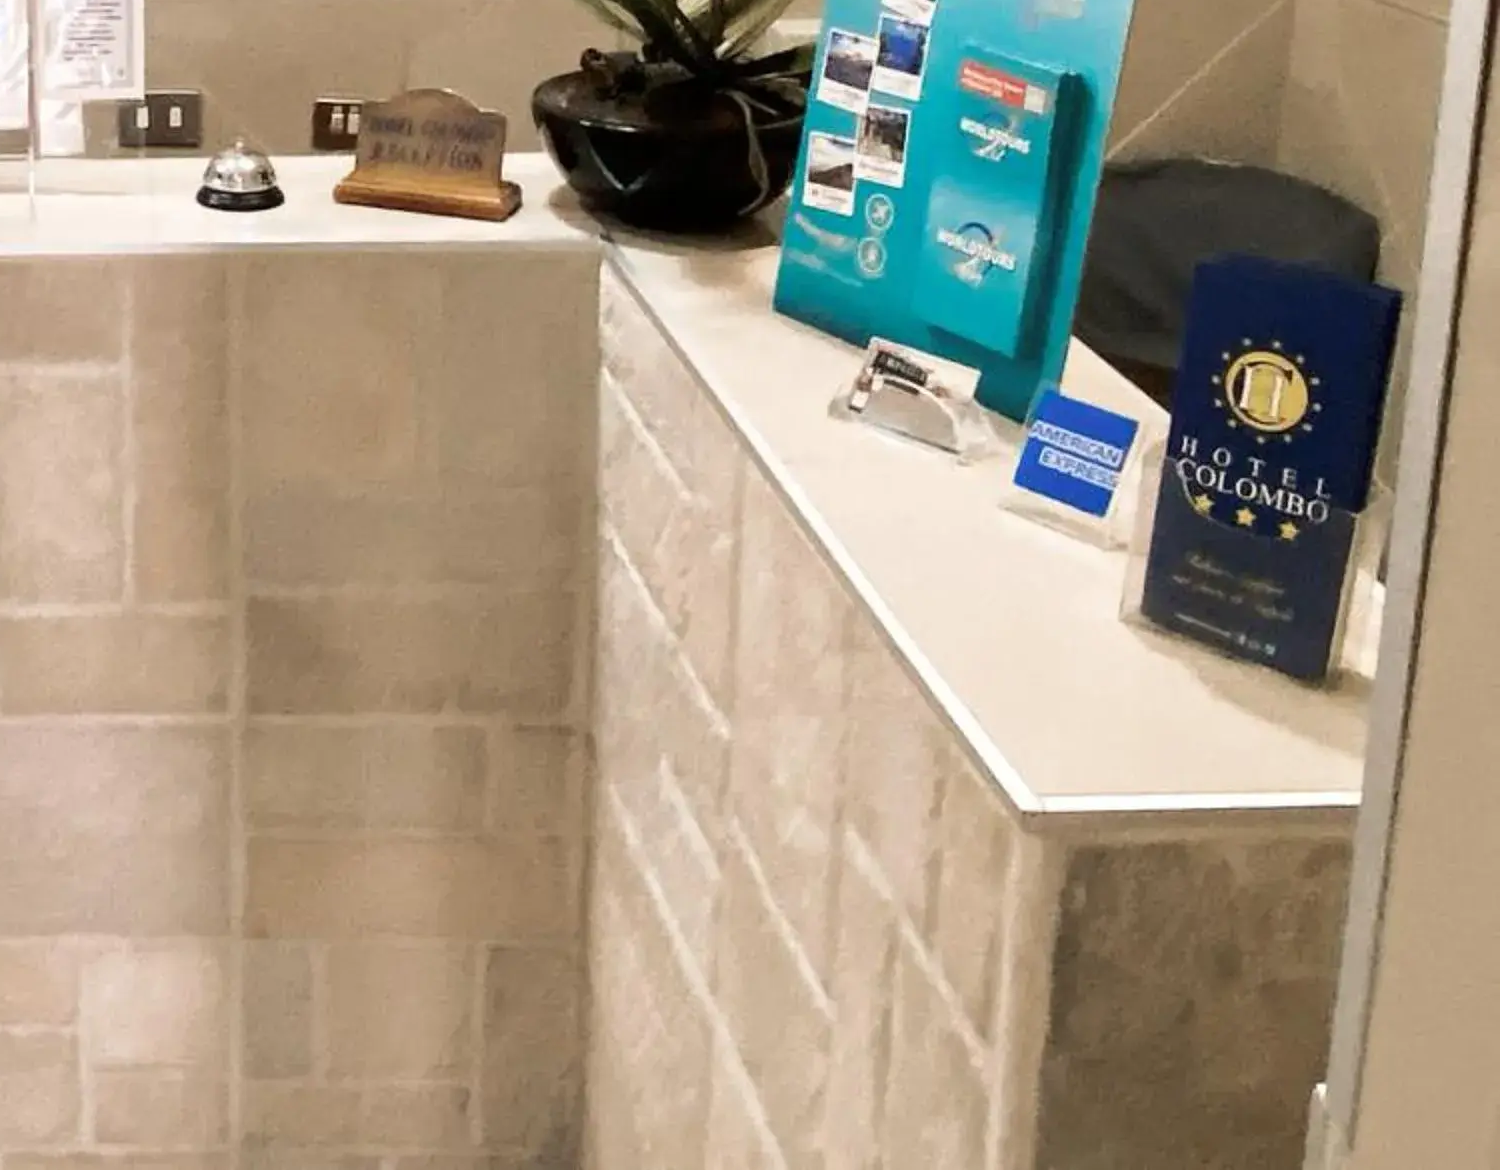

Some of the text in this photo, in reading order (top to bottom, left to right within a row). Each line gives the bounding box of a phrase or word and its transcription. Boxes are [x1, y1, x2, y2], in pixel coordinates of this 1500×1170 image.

[1028, 420, 1124, 468] AMERICAN
[1181, 435, 1332, 500] HOTEL
[1175, 456, 1330, 524] COLOMBO
